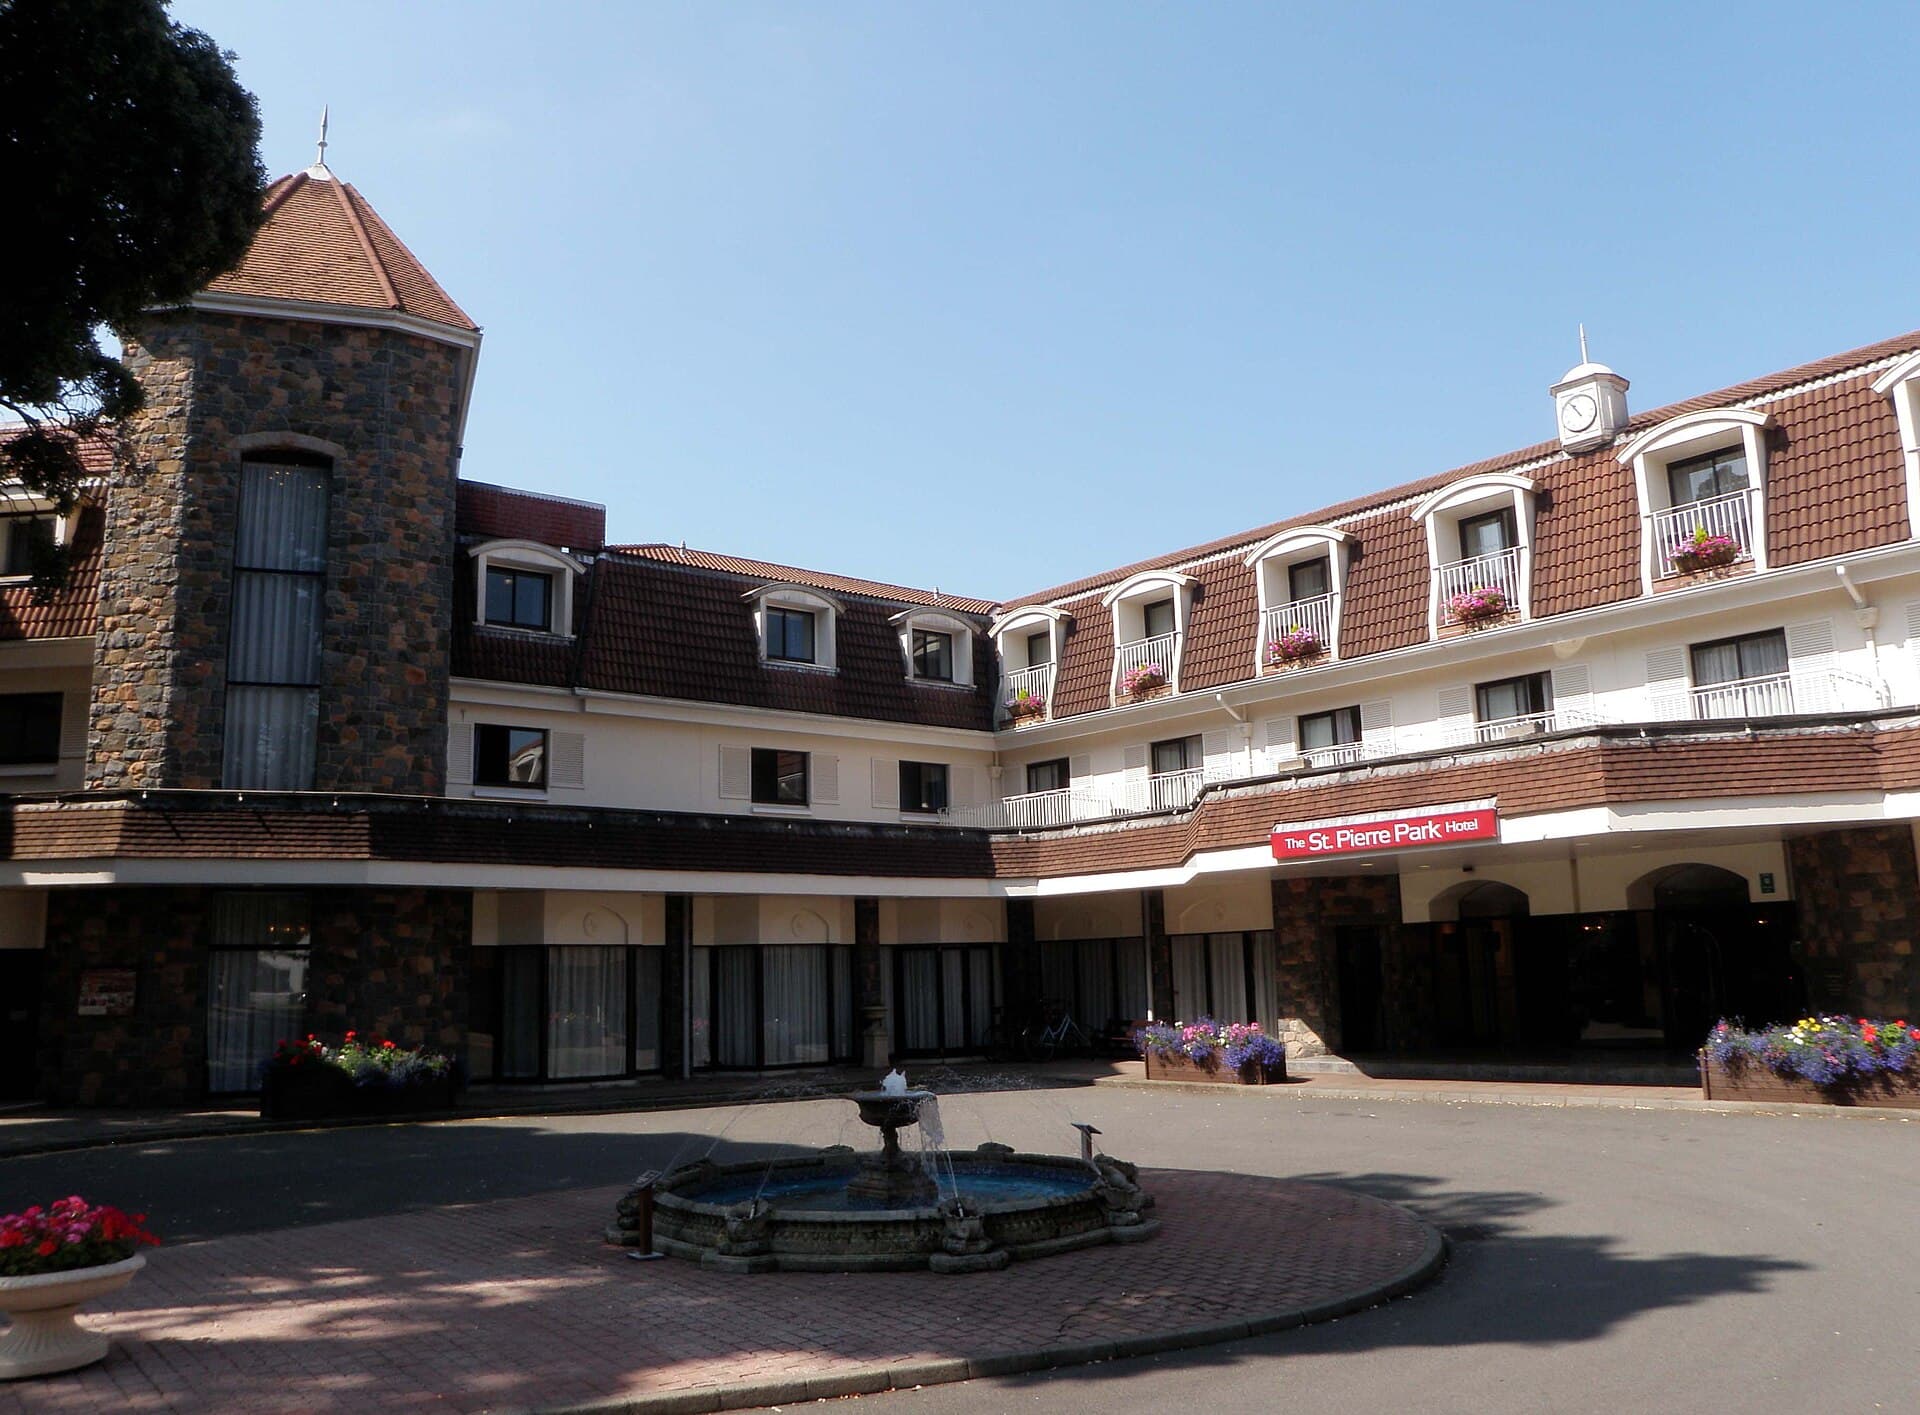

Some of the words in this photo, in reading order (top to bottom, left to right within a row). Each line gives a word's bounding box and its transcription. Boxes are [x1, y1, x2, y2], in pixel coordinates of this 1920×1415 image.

[1285, 837, 1306, 849] The
[1308, 832, 1334, 851] St.
[1336, 828, 1391, 848] Pierre
[1394, 820, 1442, 842] Park
[1445, 818, 1478, 833] Hotel
